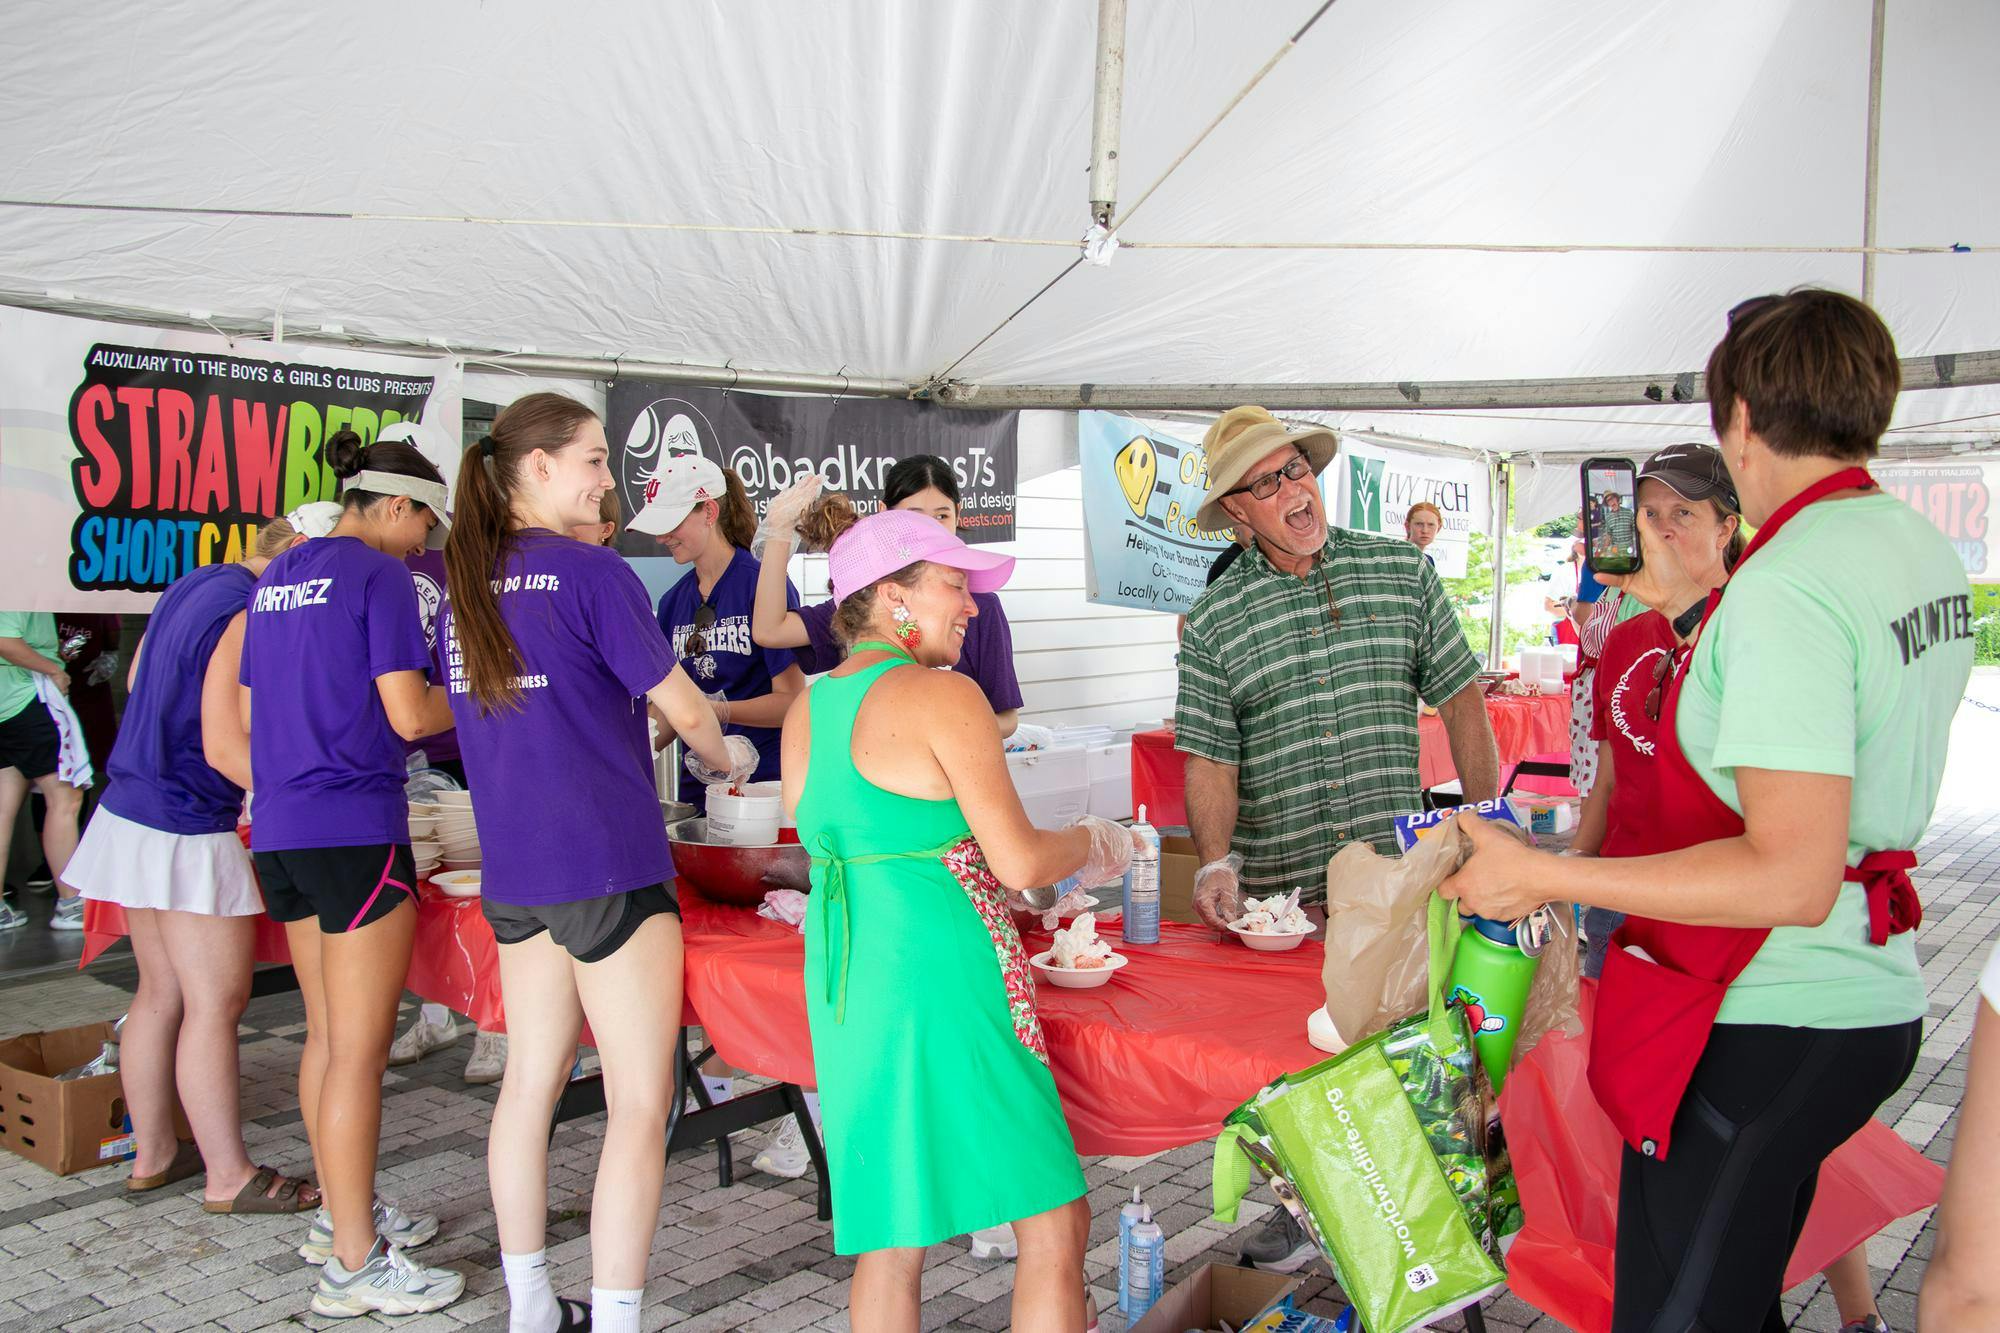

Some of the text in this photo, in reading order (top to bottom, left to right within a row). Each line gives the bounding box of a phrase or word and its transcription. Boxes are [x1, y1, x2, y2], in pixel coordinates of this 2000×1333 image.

[91, 350, 433, 396] AUXILIARY TO THE BOYS & GIRLS CLUBS PRESENTS
[1385, 472, 1470, 513] IVY TECH
[1159, 545, 1176, 563] Your
[1177, 551, 1200, 568] Brand
[253, 576, 334, 614] MARTINEZ
[503, 575, 521, 593] DO
[524, 573, 560, 592] LIST:
[1118, 581, 1194, 605] Locally Owne
[720, 615, 749, 627] SOUTH
